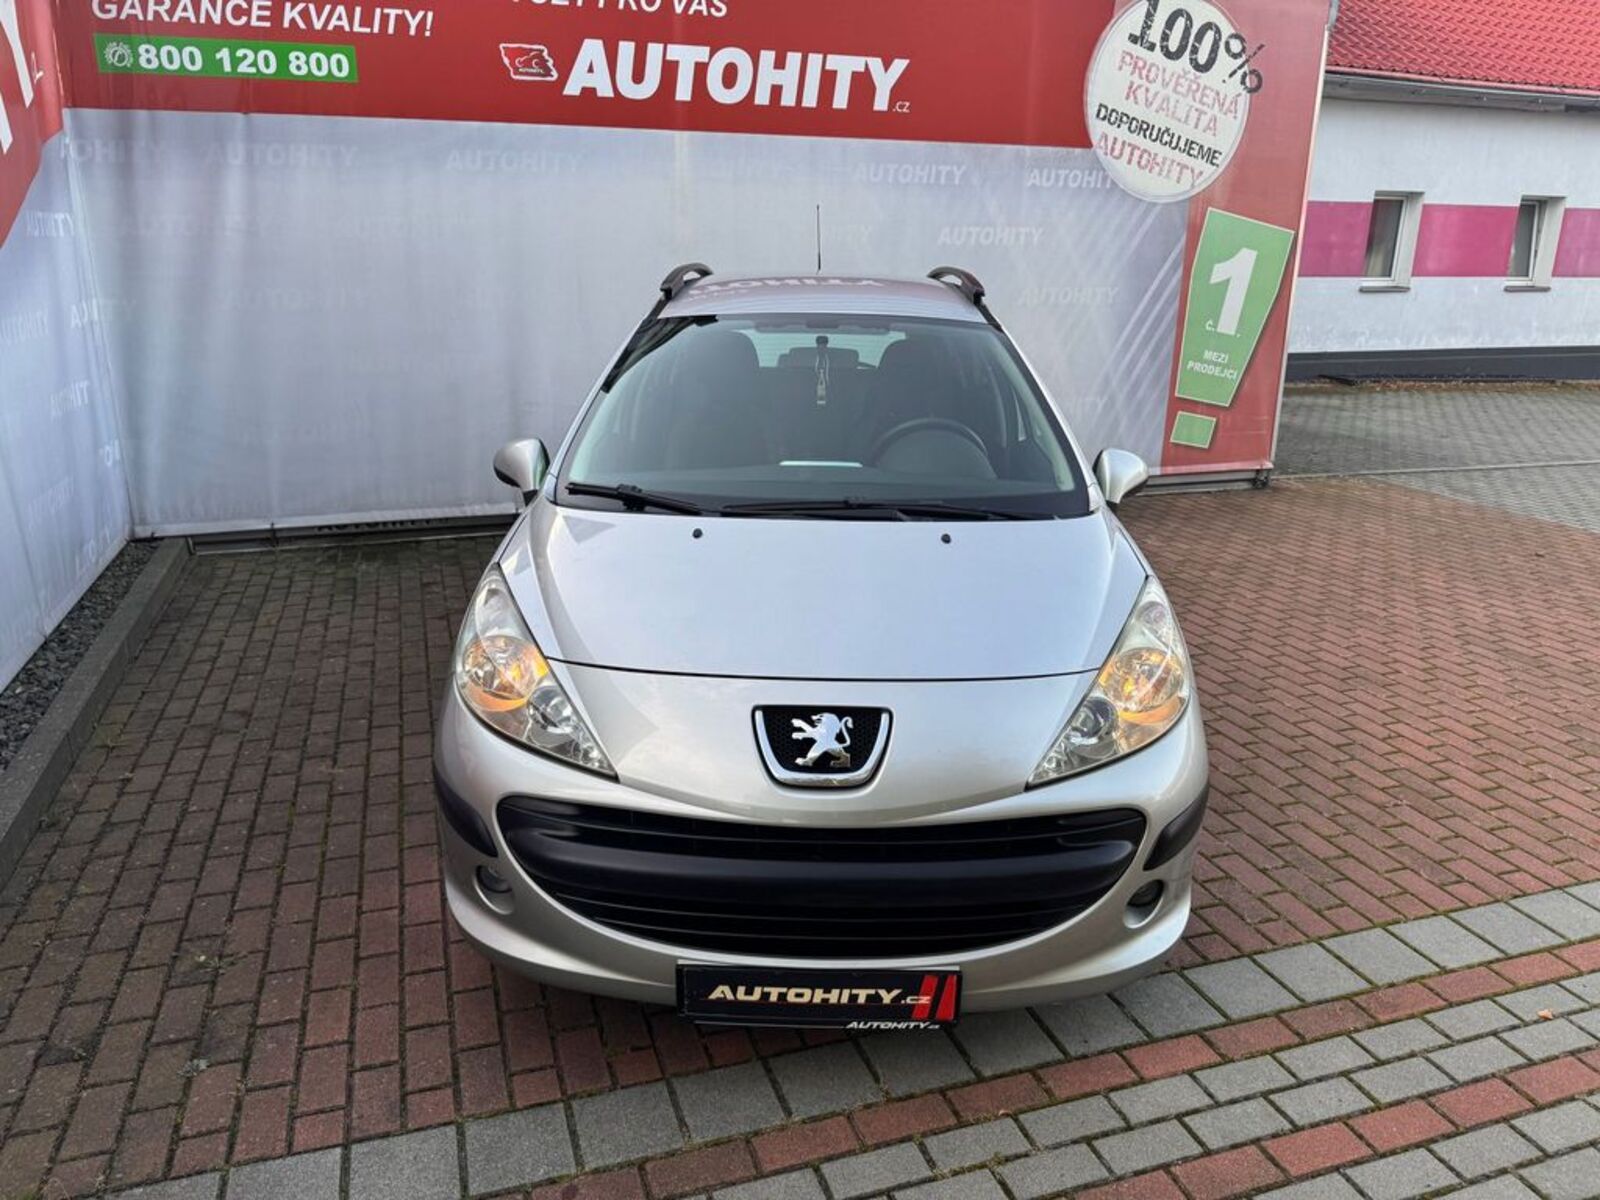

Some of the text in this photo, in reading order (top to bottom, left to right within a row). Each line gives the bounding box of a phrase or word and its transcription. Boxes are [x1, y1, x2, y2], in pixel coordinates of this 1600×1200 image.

[91, 0, 434, 37] GARANCE KVALITY!
[137, 43, 350, 78] 800 120 800
[1128, 0, 1265, 94] 100%
[1118, 51, 1241, 119] PROVĚŘENÁ
[1124, 81, 1219, 137] KVALITA
[1094, 131, 1204, 189] AUTOHITY
[1095, 103, 1223, 168] DOPORUČUJEME
[1187, 360, 1239, 381] PRODEJCI
[1203, 349, 1230, 365] MEZI
